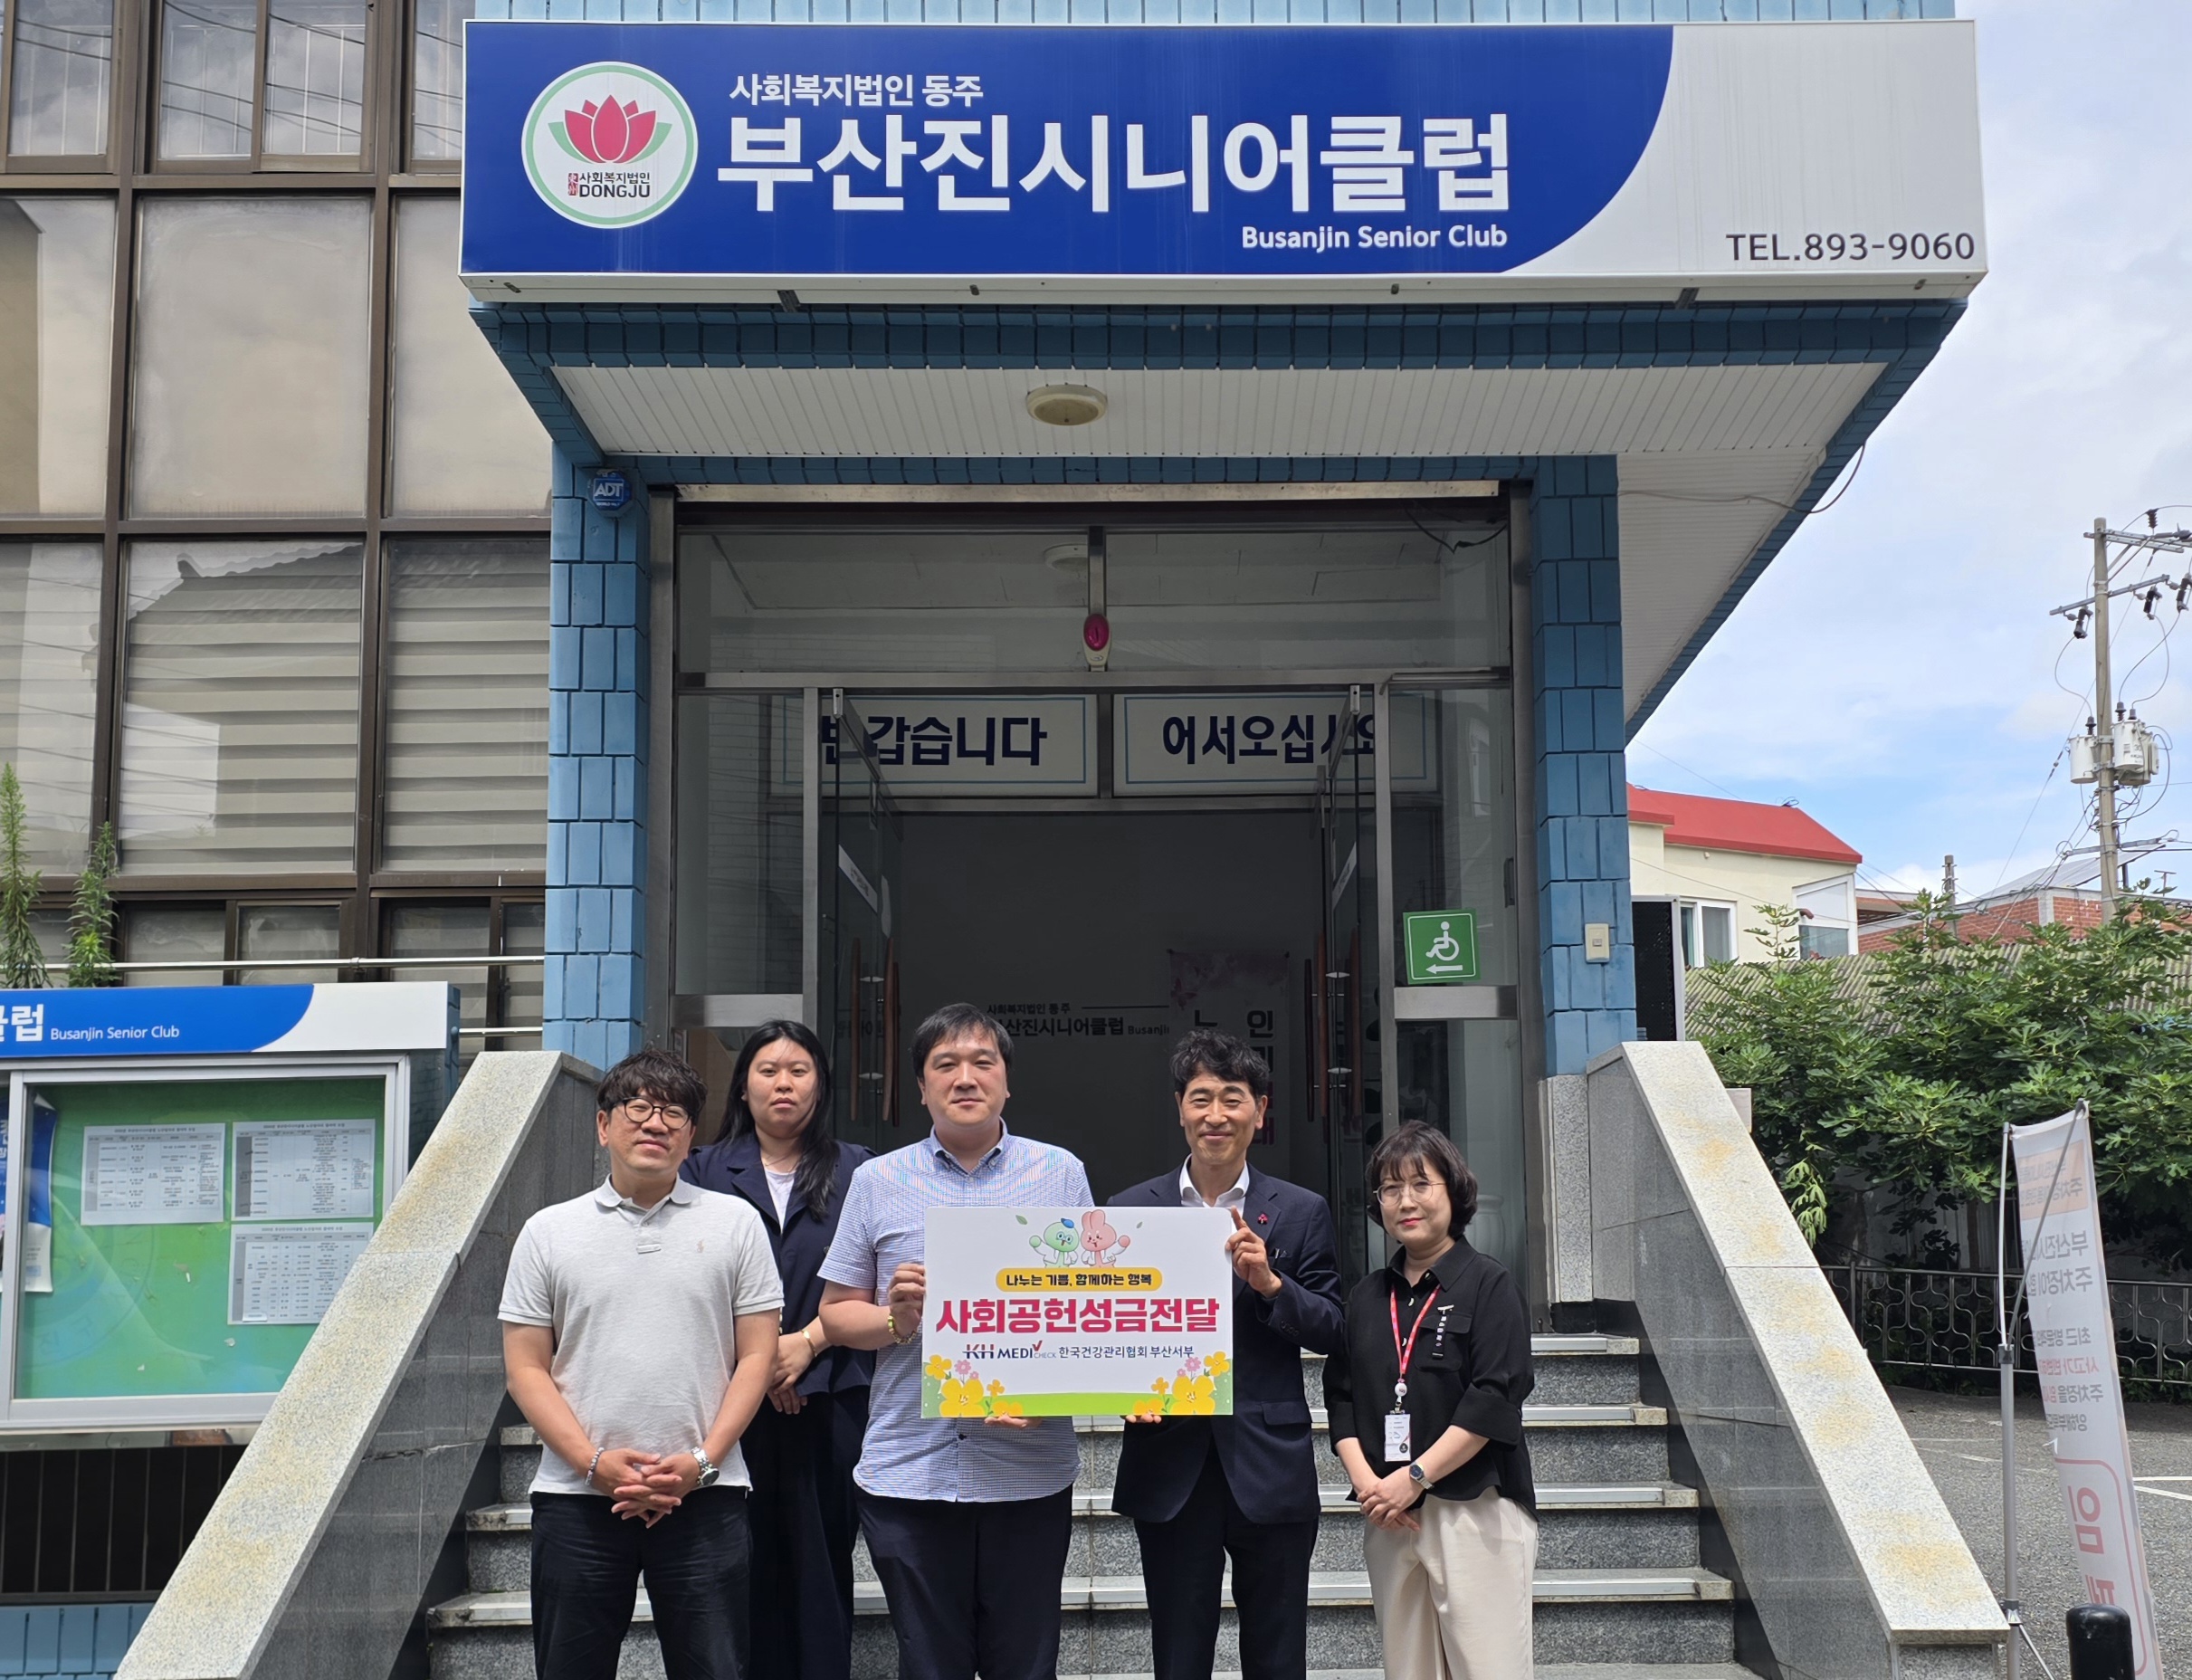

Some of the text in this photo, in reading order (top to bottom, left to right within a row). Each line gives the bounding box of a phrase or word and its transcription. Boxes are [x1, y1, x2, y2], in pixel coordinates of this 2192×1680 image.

[729, 73, 984, 107] 사회복지법인 동주
[717, 113, 1509, 212] 부산진시니어클럽
[579, 172, 651, 185] 사회복지법인
[579, 185, 651, 197] DONGJU
[1242, 224, 1508, 253] Busanjin Senior Club
[1725, 232, 1975, 261] TEL.893-9060
[594, 482, 624, 497] ADT
[986, 1004, 1046, 1015] 사회복지법인
[0, 1004, 43, 1042] 럽
[1001, 1017, 1124, 1037] 산진시니어클럽
[51, 1026, 180, 1042] Busanjin Senior Club
[1006, 1274, 1043, 1286] 나누는
[1075, 1274, 1124, 1286] 함께하는
[1128, 1273, 1152, 1285] 행복
[936, 1297, 1220, 1334] 사회공헌성금전달
[1059, 1346, 1195, 1359] 한국건강관리협회 부산서부
